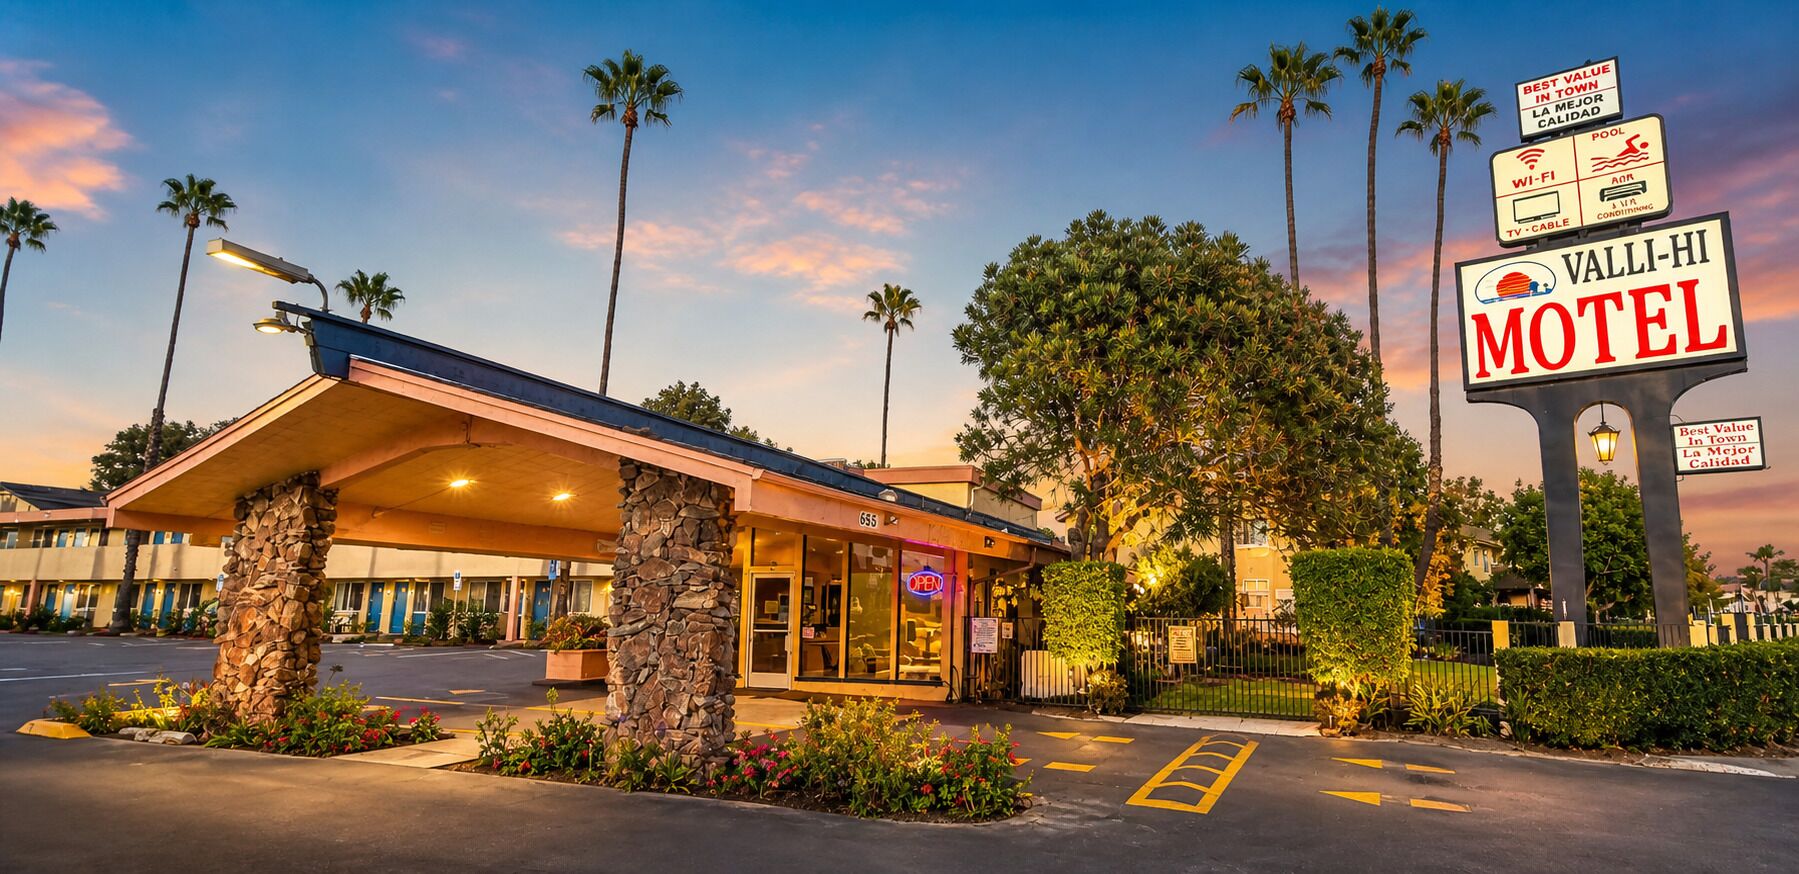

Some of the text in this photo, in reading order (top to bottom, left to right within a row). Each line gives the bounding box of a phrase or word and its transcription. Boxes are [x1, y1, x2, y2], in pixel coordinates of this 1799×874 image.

[1523, 64, 1611, 95] BEST VALUE
[1536, 80, 1598, 103] IN TOWN
[1532, 93, 1604, 118] LA MEJOR
[1538, 106, 1601, 128] CALIDAD
[1591, 127, 1626, 141] POOL
[1512, 170, 1555, 188] WI-FI
[1506, 217, 1570, 237] TV CABLE
[1561, 229, 1710, 285] VALLI-HI
[1471, 278, 1728, 378] MOTEL
[1680, 422, 1754, 437] Best Value
[1688, 434, 1747, 445] In Town
[1683, 449, 1701, 458] La
[1689, 455, 1751, 469] Calidad
[909, 575, 941, 592] OPEN
